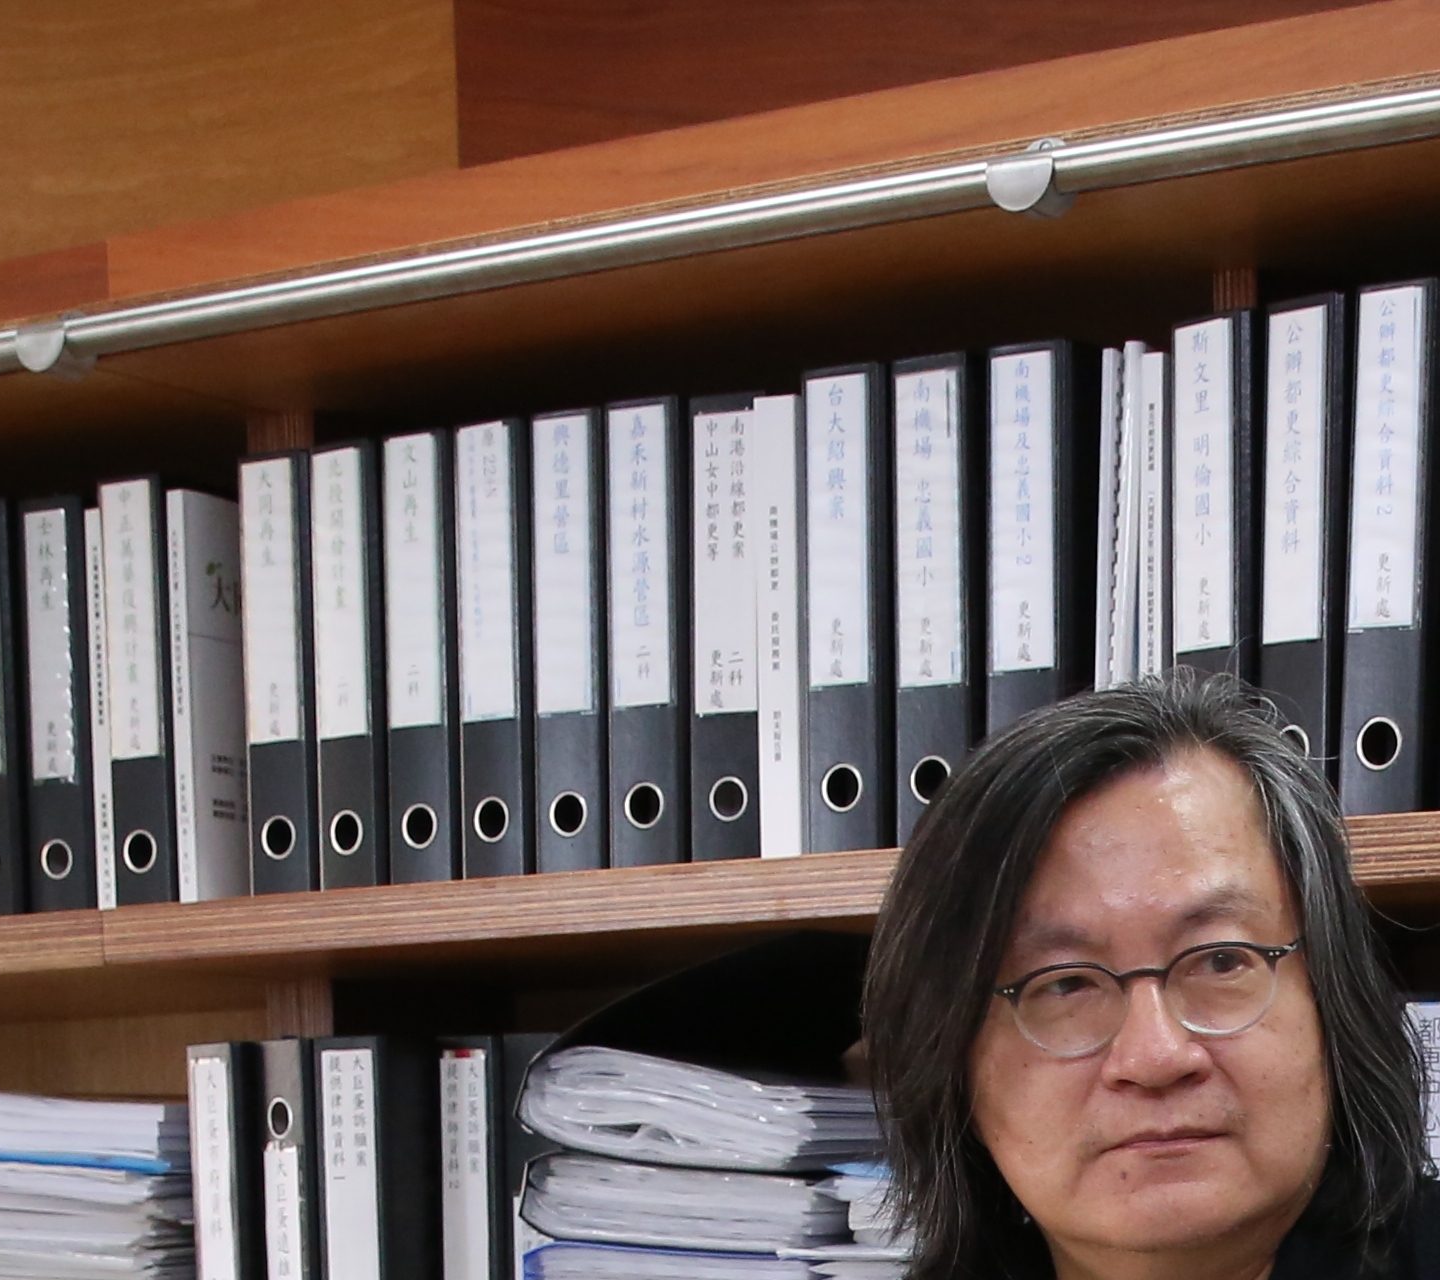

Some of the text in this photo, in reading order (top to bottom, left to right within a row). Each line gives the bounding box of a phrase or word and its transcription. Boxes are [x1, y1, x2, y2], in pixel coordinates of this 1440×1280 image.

[1191, 330, 1209, 413] 斯文里
[828, 383, 846, 520] 台大紹興案
[913, 378, 932, 460] 南機場
[1281, 319, 1303, 554] 公辦都更綜合資料
[914, 478, 934, 588] 忠義國小
[1197, 577, 1211, 641] 更新處
[1376, 553, 1392, 619] 更新處
[728, 651, 744, 686] 二科
